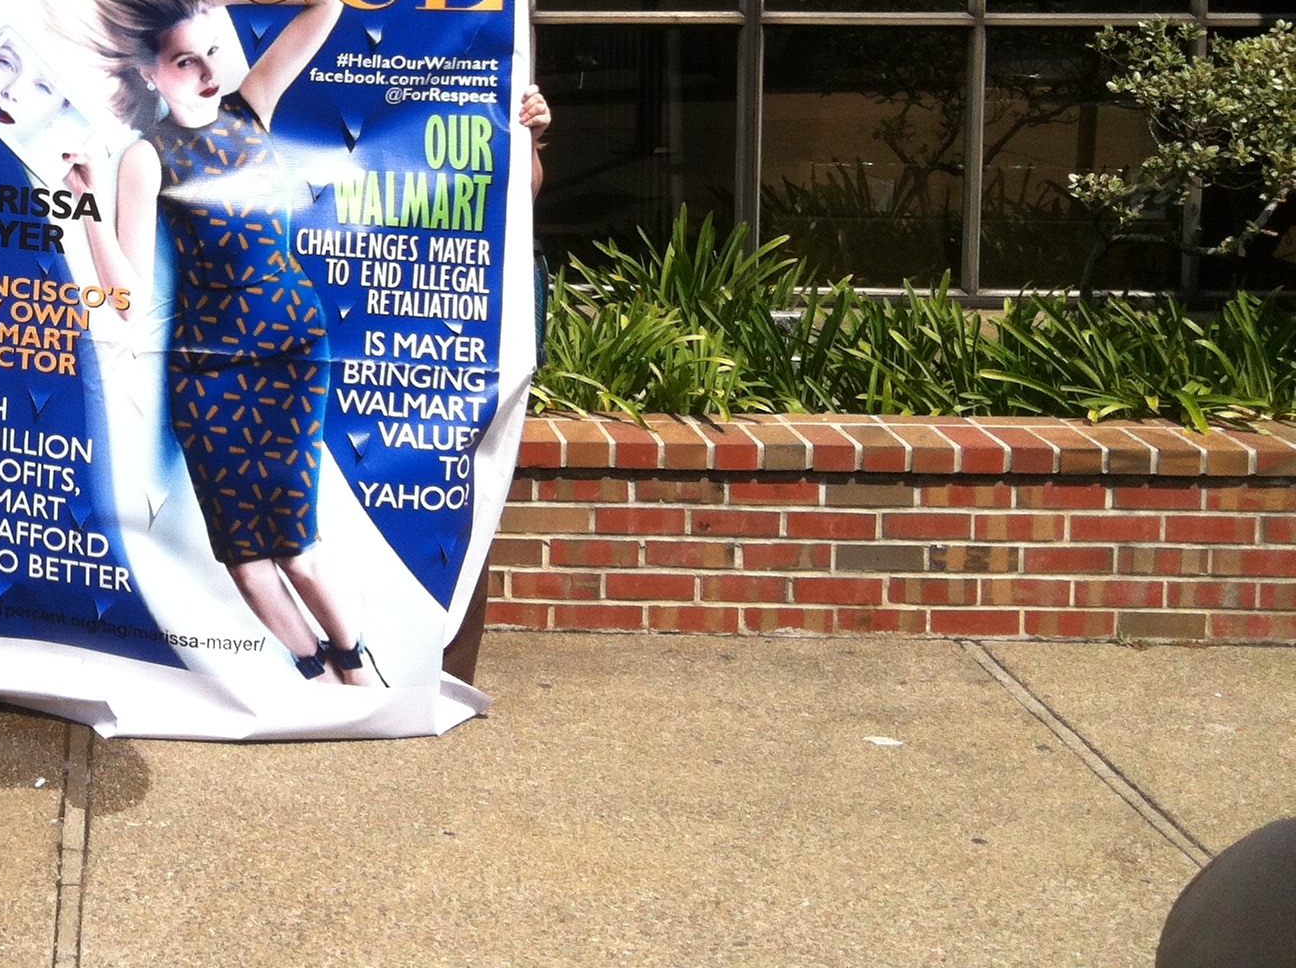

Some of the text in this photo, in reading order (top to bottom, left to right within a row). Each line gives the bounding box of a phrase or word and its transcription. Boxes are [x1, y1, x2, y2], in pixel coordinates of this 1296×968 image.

[309, 68, 498, 87] facebook.com/ourwmt
[336, 53, 499, 71] #HellaOurWalmart
[385, 87, 497, 107] @ForRespect
[424, 114, 494, 172] OUR
[333, 169, 492, 232] WALMART
[296, 229, 491, 266] CHALLENGES MAYER
[326, 259, 490, 294] TO END ILLEGAL
[10, 302, 90, 331] OWN
[367, 289, 487, 321] RETALIATION
[365, 331, 487, 363] IS MAYER
[343, 361, 486, 392] BRINGING
[336, 388, 488, 422] WALMART
[378, 422, 480, 450] VALUES
[439, 454, 470, 482] TO
[28, 553, 133, 592] BETTER
